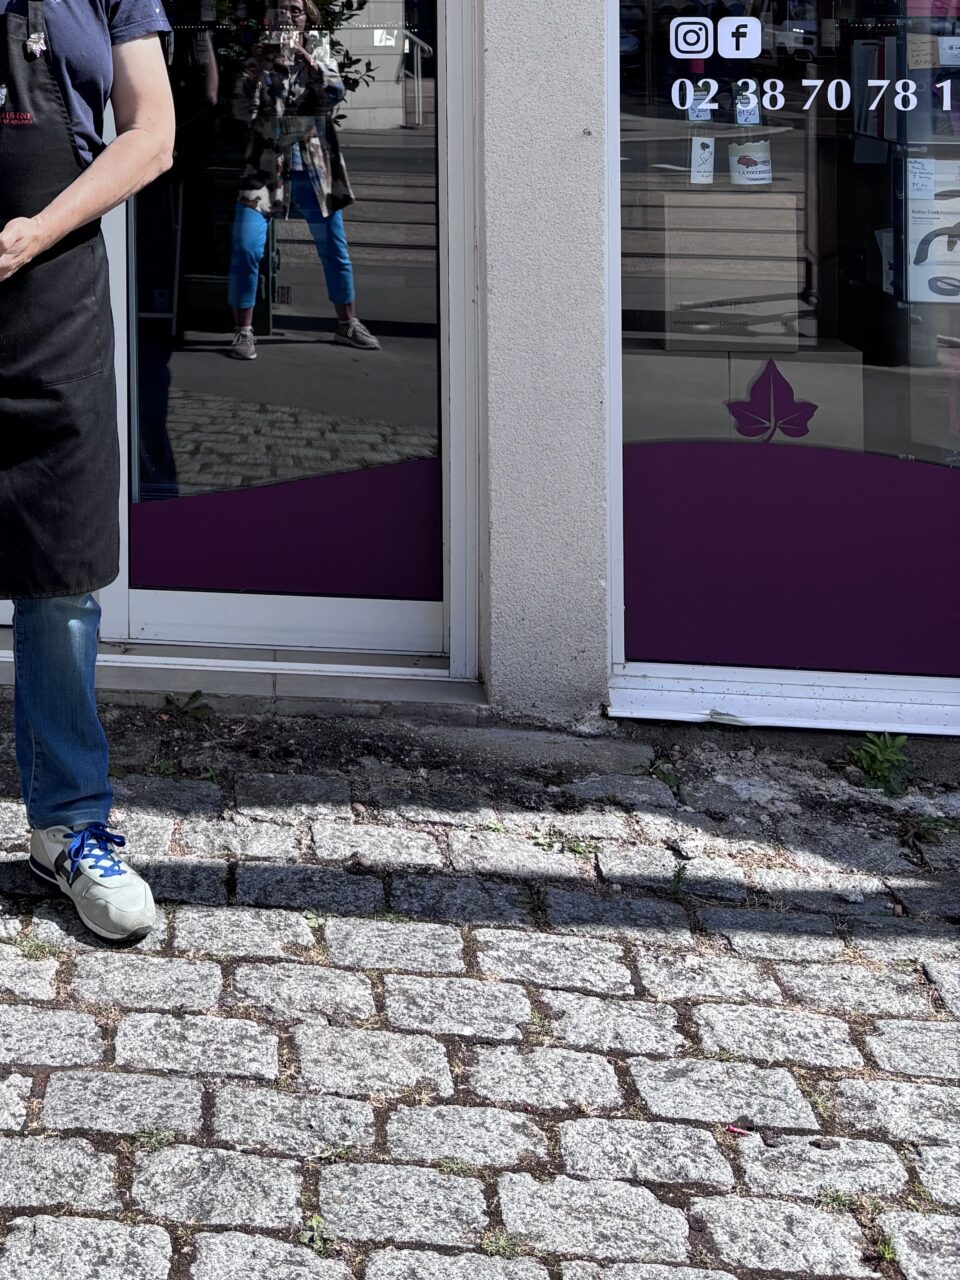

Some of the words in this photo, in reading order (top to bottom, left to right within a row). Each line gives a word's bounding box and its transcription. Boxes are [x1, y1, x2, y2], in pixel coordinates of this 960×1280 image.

[671, 78, 719, 111] 02
[736, 78, 785, 111] 38
[801, 78, 851, 111] 70
[867, 78, 918, 111] 78
